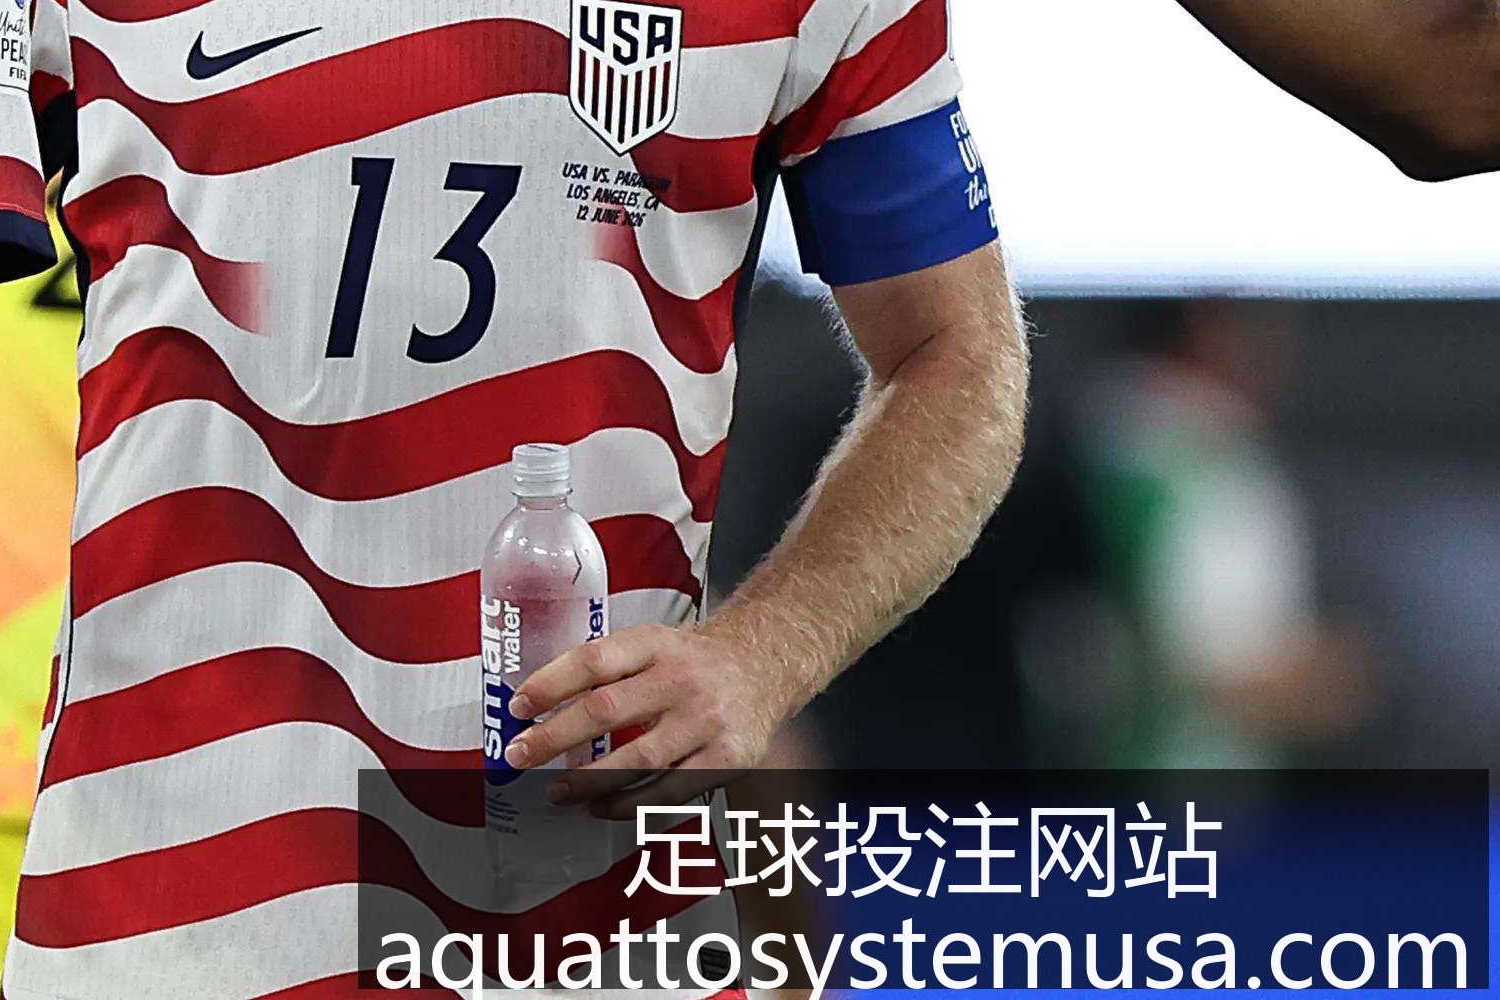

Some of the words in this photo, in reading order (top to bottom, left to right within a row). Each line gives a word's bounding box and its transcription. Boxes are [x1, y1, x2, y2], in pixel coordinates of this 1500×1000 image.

[1, 38, 29, 66] PEA
[579, 5, 673, 66] USA
[562, 162, 588, 180] USA
[592, 166, 610, 183] VS.
[566, 183, 591, 201] LOS
[592, 187, 641, 209] ANGELES,
[644, 196, 661, 212] CA
[576, 205, 590, 221] 12
[591, 208, 620, 225] JUNE
[325, 157, 523, 363] 13
[502, 601, 520, 673] water
[586, 598, 604, 642] ter
[481, 595, 502, 760] smart
